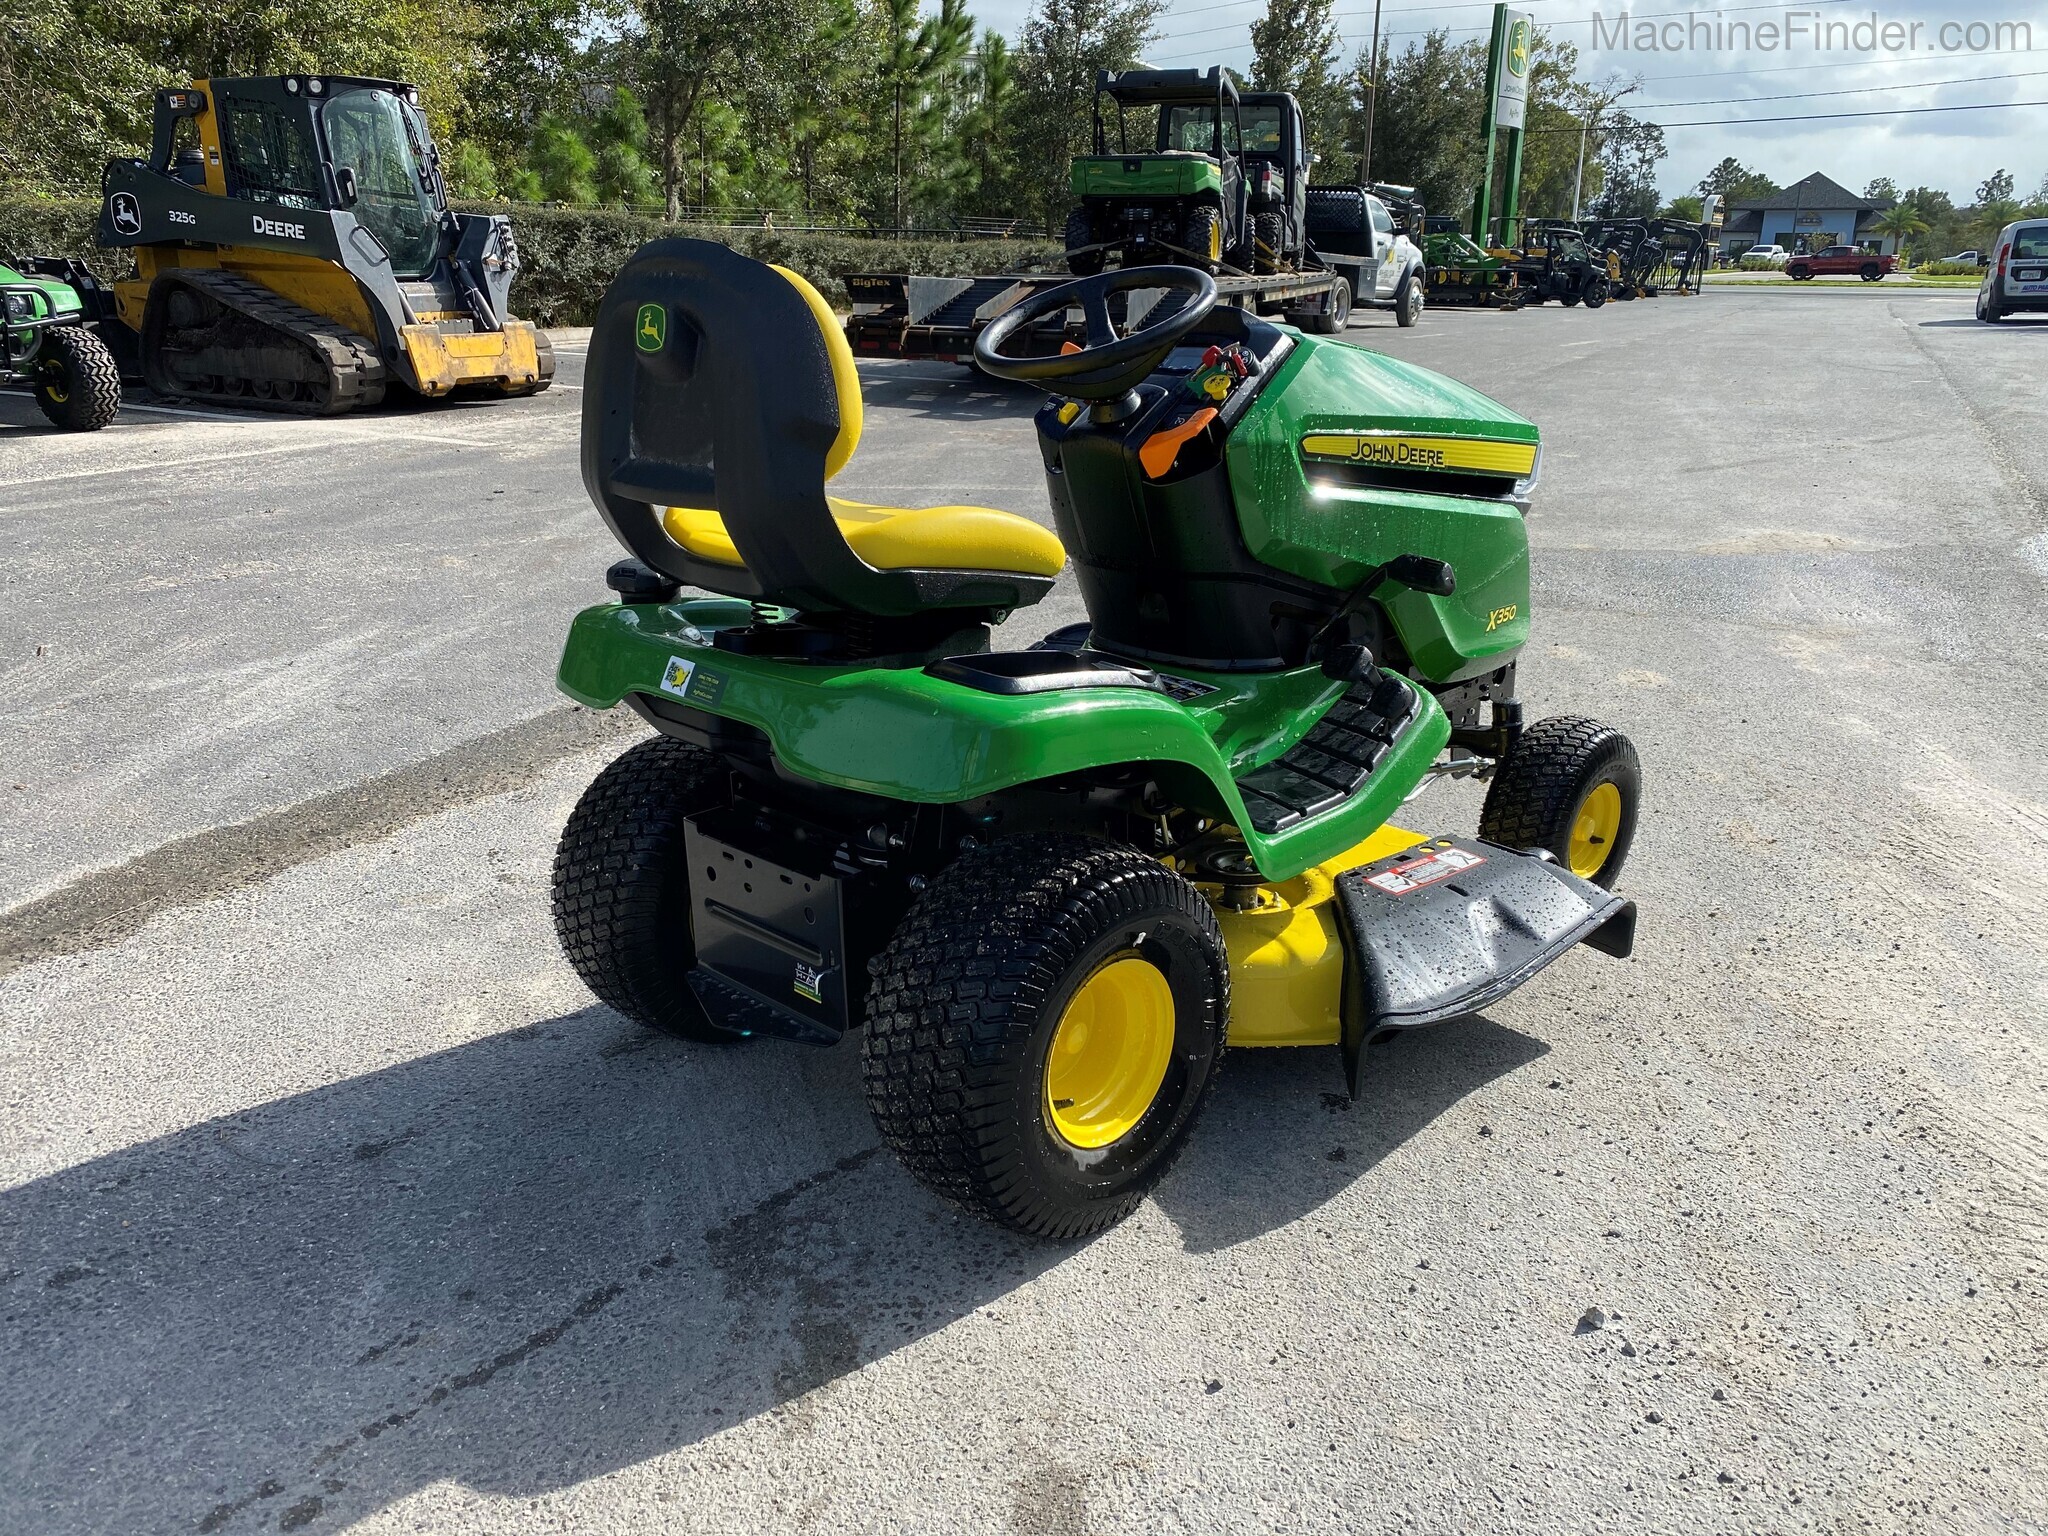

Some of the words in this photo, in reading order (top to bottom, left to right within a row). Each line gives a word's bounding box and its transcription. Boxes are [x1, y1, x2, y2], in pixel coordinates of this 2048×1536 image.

[168, 210, 196, 225] 325G
[252, 215, 306, 240] DEERE
[852, 278, 890, 287] BigTex
[1351, 438, 1396, 461] JOHN
[1398, 443, 1445, 466] DEERE
[1485, 604, 1517, 632] X350
